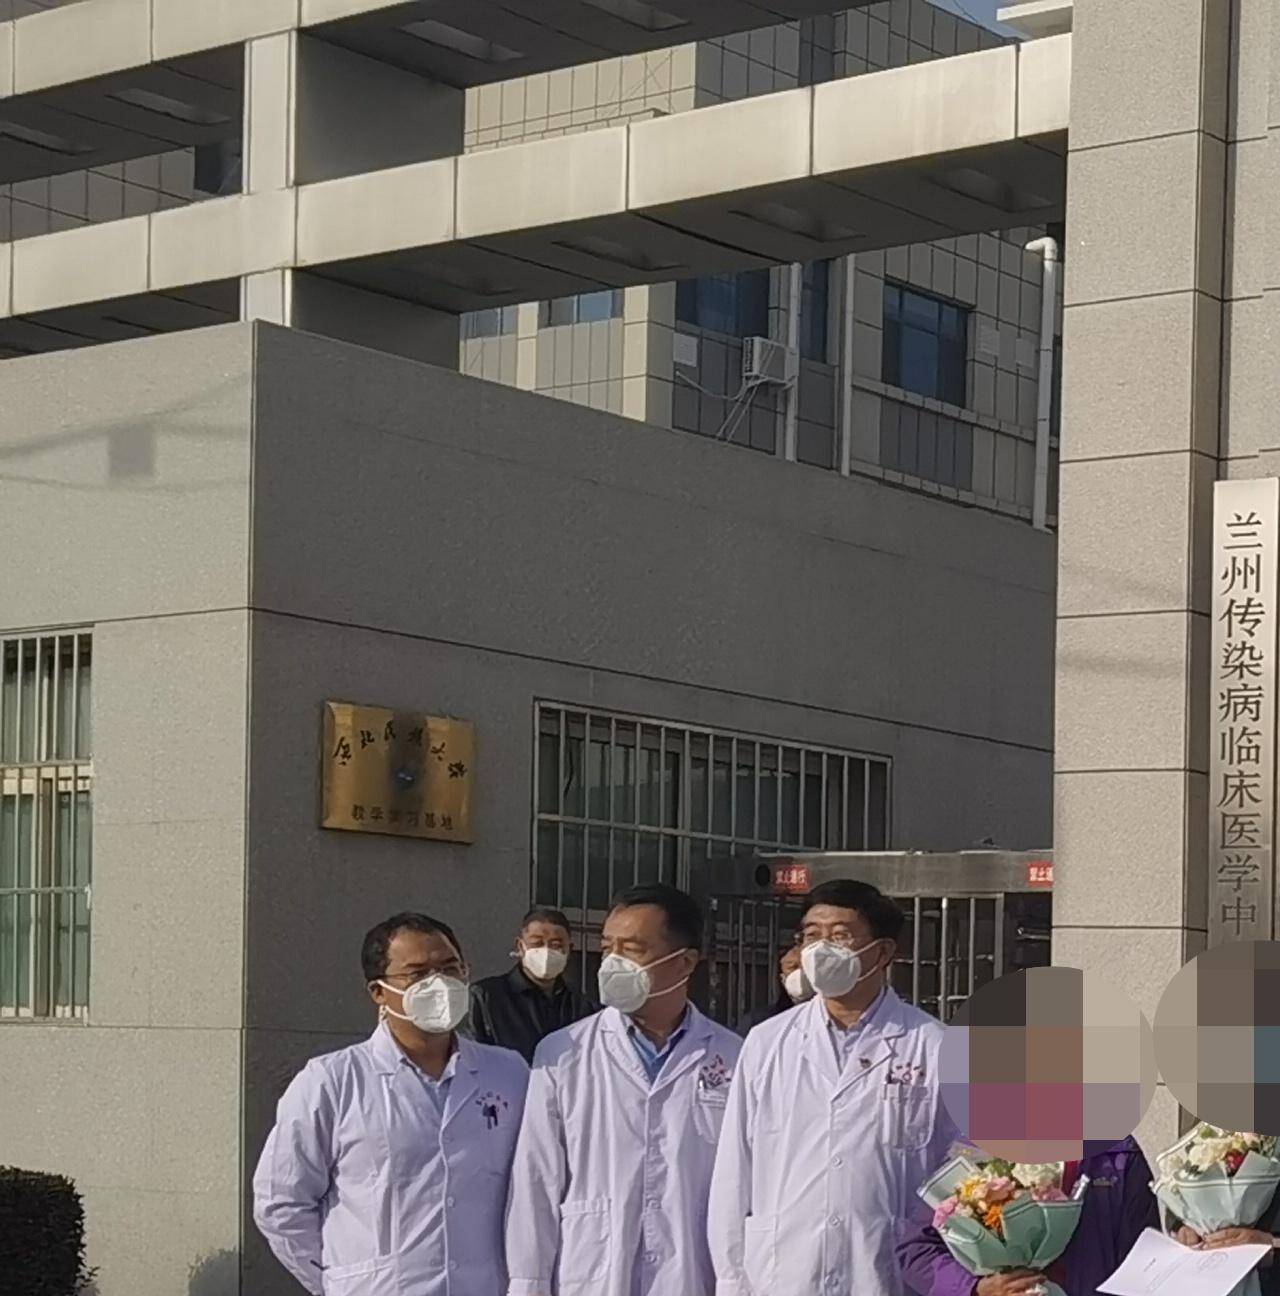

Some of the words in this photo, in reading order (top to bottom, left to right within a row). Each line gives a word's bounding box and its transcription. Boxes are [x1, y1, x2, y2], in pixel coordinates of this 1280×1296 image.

[1216, 512, 1266, 936] 兰州传染病临床医学中
